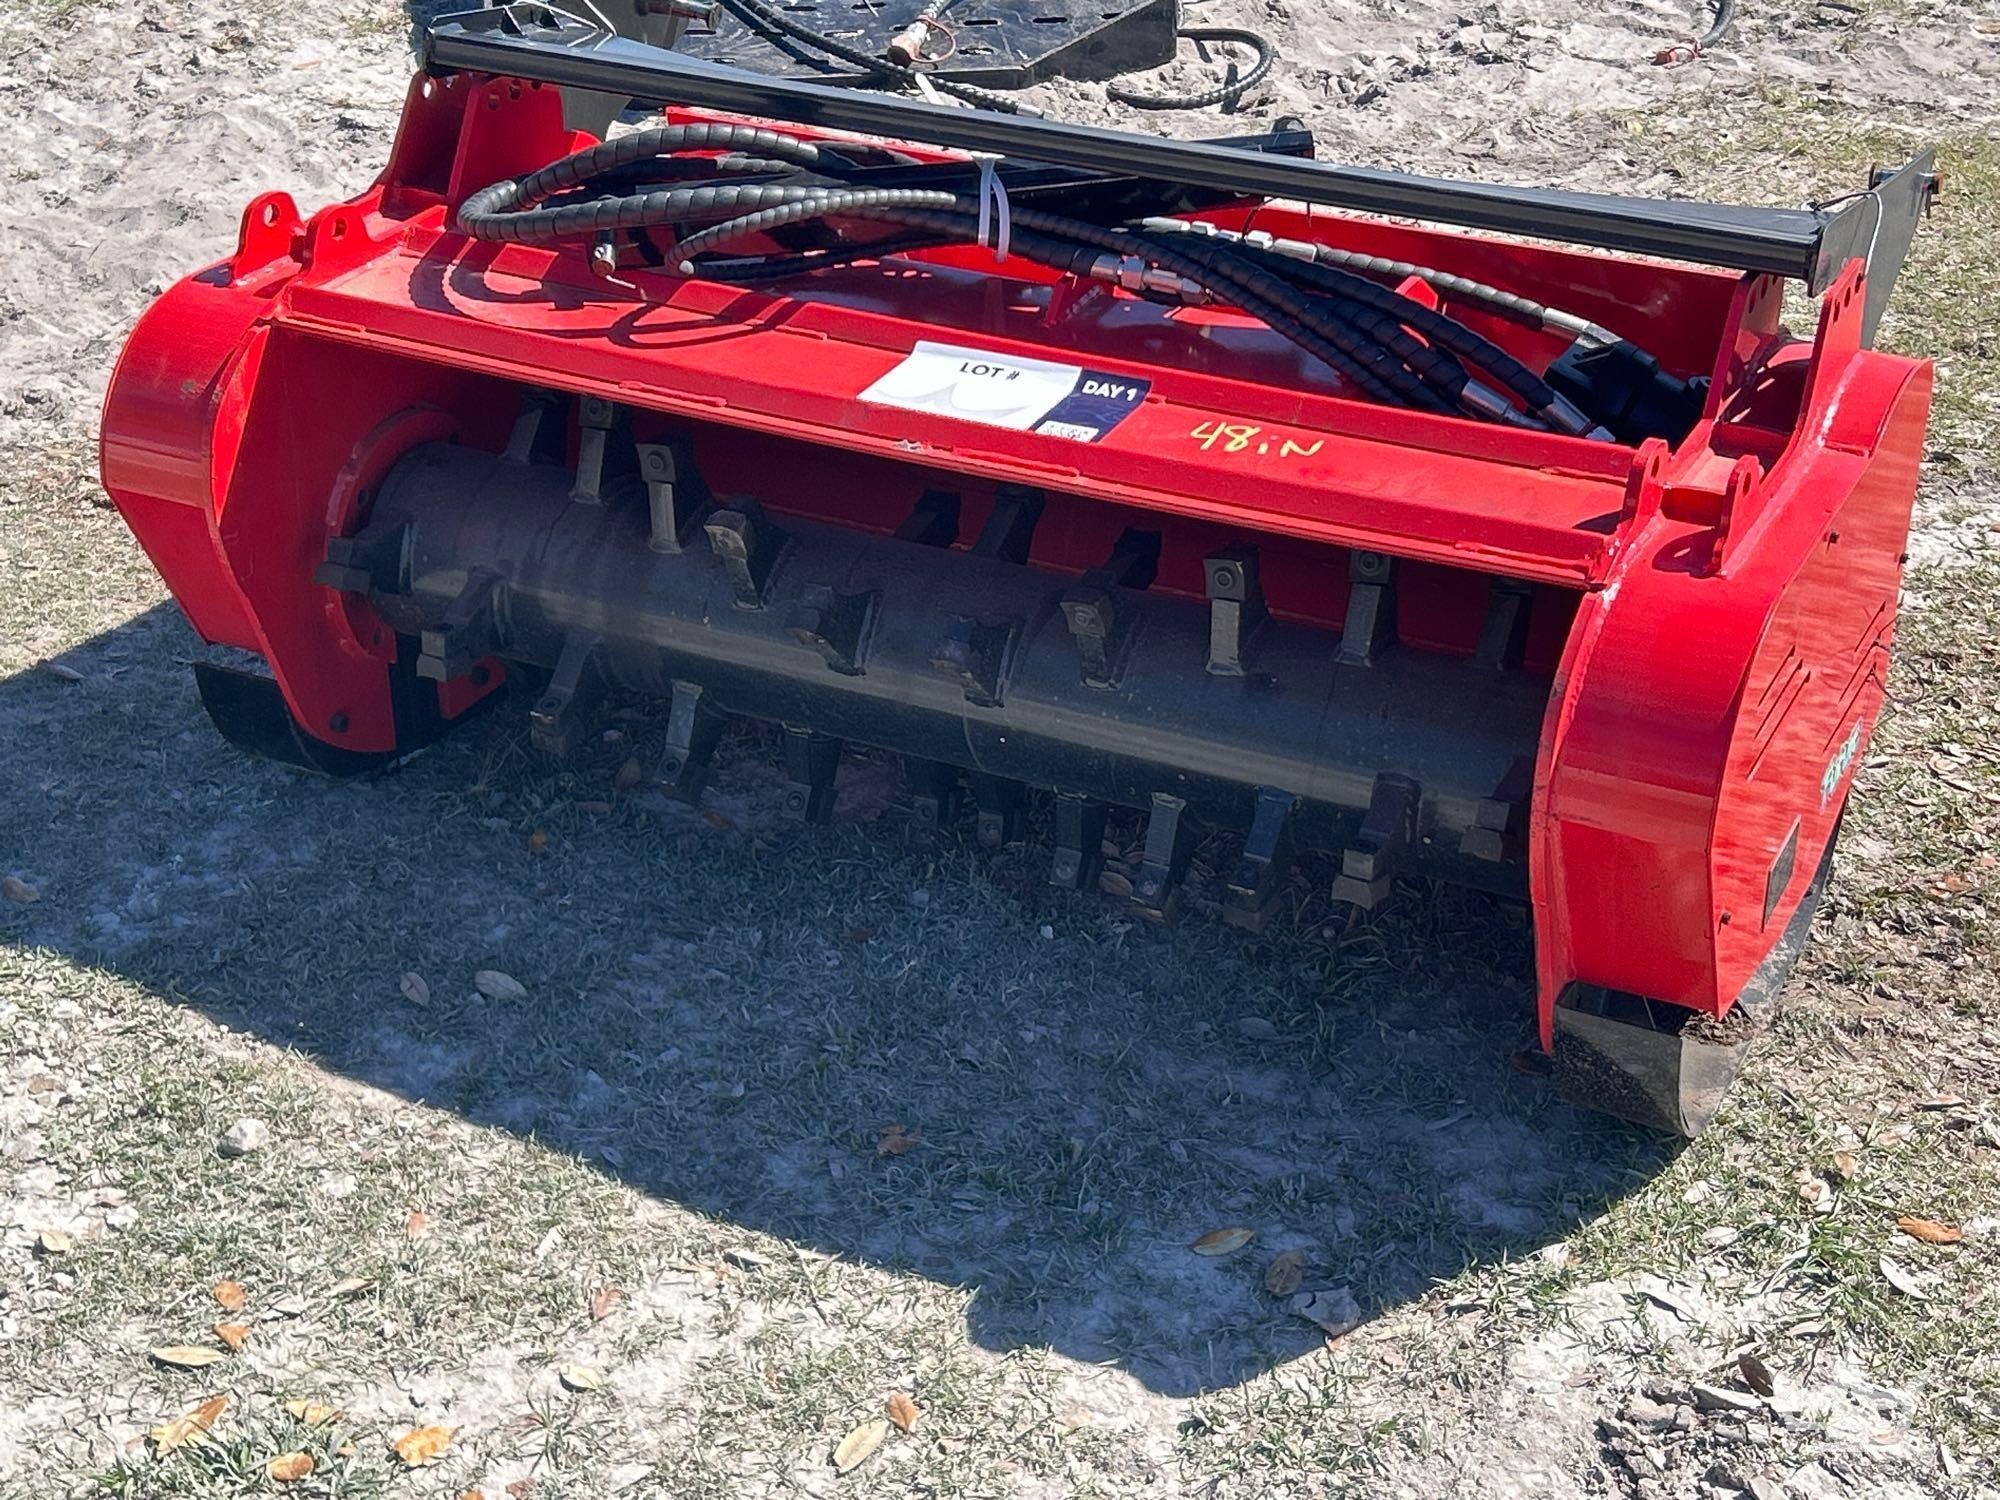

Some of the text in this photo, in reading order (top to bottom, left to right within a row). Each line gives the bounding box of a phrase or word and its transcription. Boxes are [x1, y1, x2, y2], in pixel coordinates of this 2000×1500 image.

[959, 362, 1020, 381] LOT #
[1081, 380, 1138, 402] DAY 1
